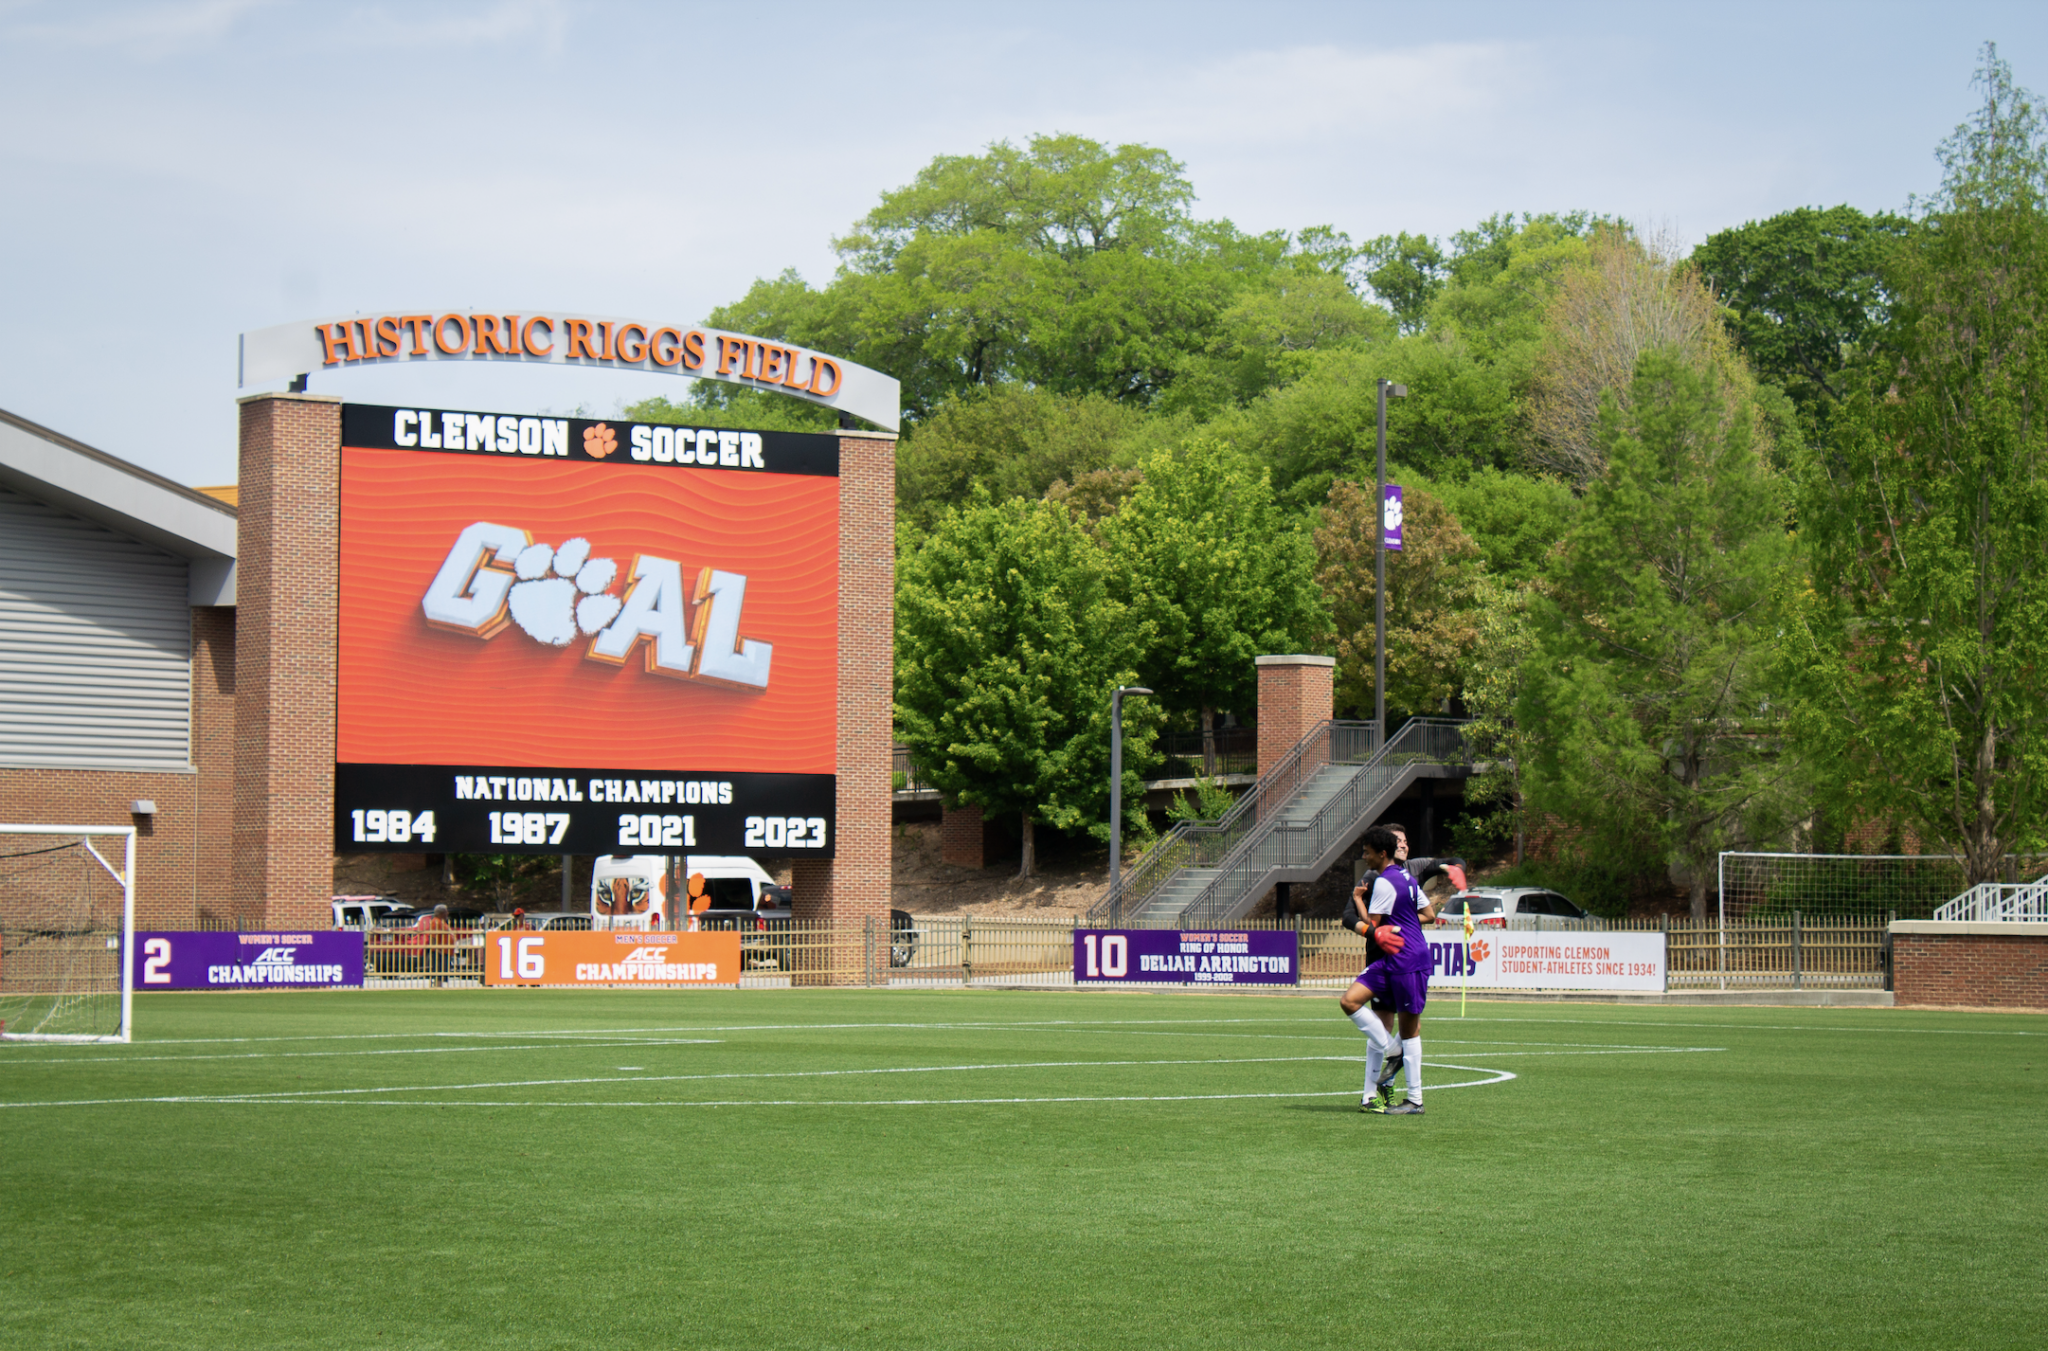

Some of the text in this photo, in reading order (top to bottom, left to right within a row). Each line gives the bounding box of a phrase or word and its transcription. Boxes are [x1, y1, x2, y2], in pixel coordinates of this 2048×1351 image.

[317, 313, 843, 397] HISTORIC RIGGS FIELD
[393, 409, 765, 469] CLEMSON SOCCER
[455, 775, 733, 805] NATIONAL CHAMPIONS
[351, 809, 827, 848] 1984 1987 2021 2023
[238, 934, 314, 945] WOMEN'S SOCCER
[615, 934, 678, 945] MEN'S SOCCER
[1179, 933, 1249, 943] WOMEN'S SOCCER
[255, 947, 297, 962] ACC
[622, 946, 668, 961] ACC
[1084, 935, 1128, 977] 10
[1180, 942, 1249, 954] RING OF HONOR
[1501, 946, 1610, 960] SUPPORTING CLEMSON
[143, 937, 172, 984] 2
[497, 936, 545, 980] 16
[1140, 955, 1290, 974] DELIAH ARRINGTON
[208, 965, 343, 983] CHAMPIONSHIPS
[575, 963, 718, 981] CHAMPIONSHIPS
[1501, 961, 1656, 977] STUDENT-ATHLETES SINCE 1934!
